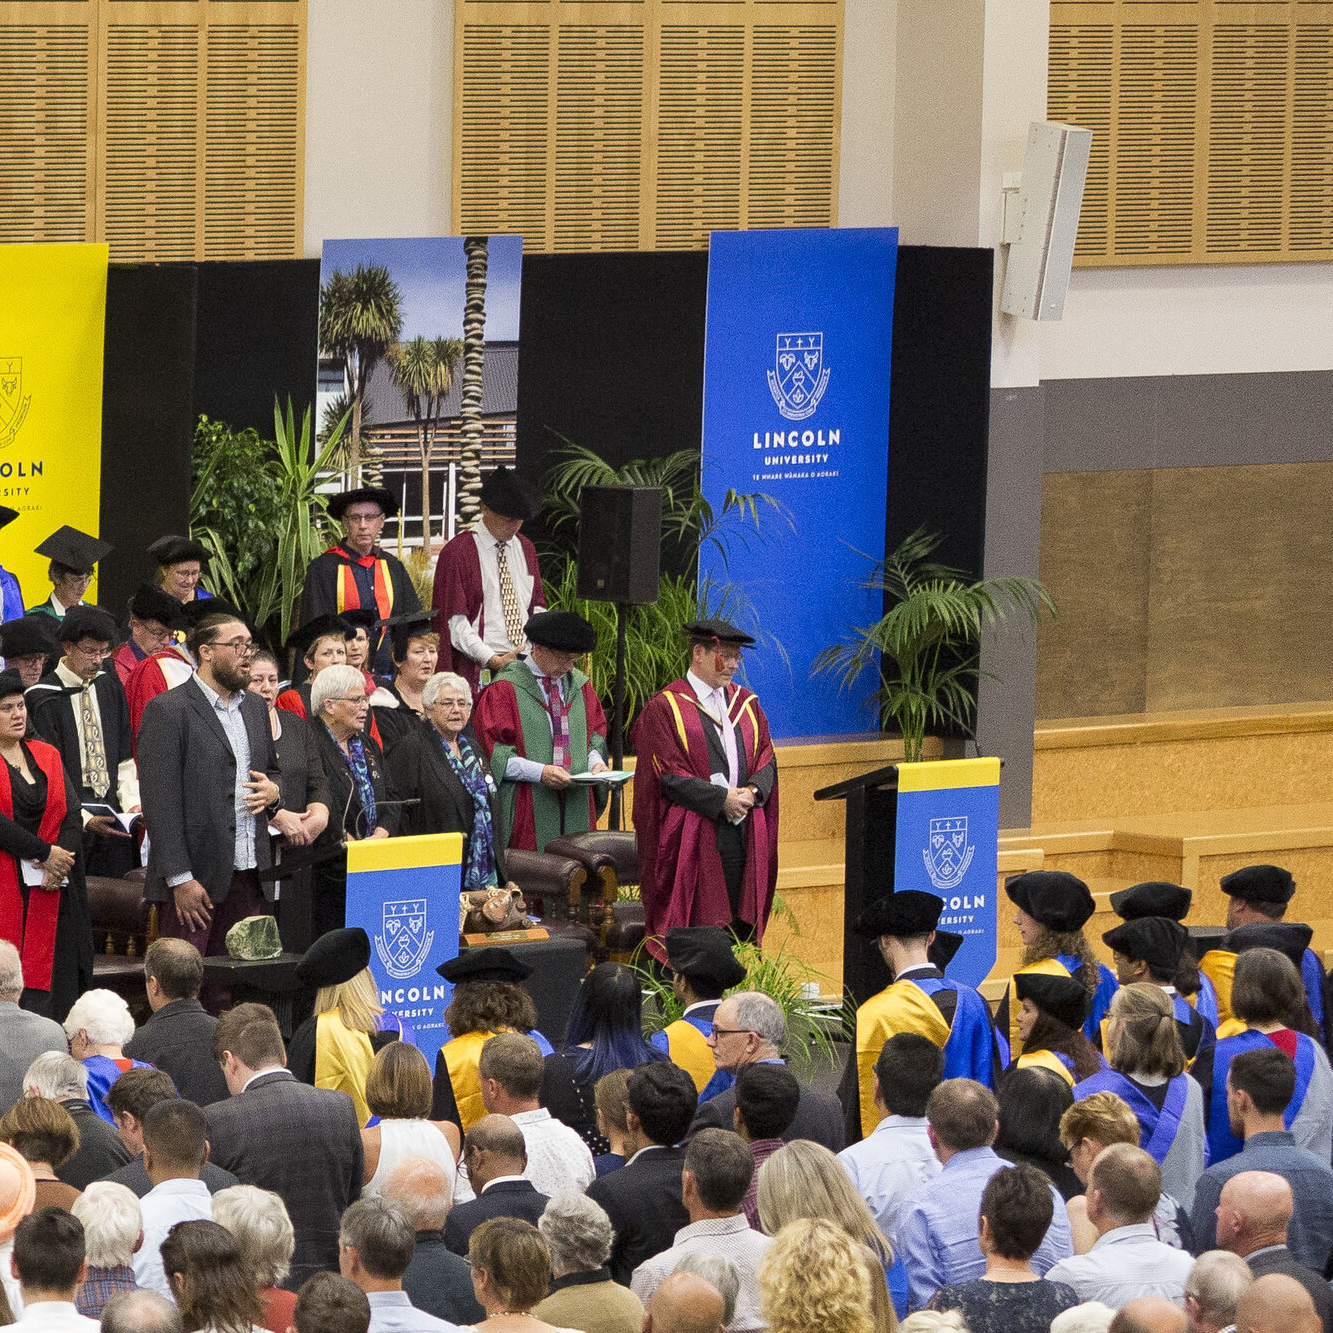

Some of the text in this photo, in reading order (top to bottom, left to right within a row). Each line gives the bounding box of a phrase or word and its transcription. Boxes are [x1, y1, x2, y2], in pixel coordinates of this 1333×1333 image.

[753, 428, 841, 449] LINCOLN
[764, 453, 829, 466] UNIVERSITY
[940, 915, 974, 925] ERSITY
[381, 985, 445, 1005] NCOLN
[392, 1008, 434, 1018] VERSITY
